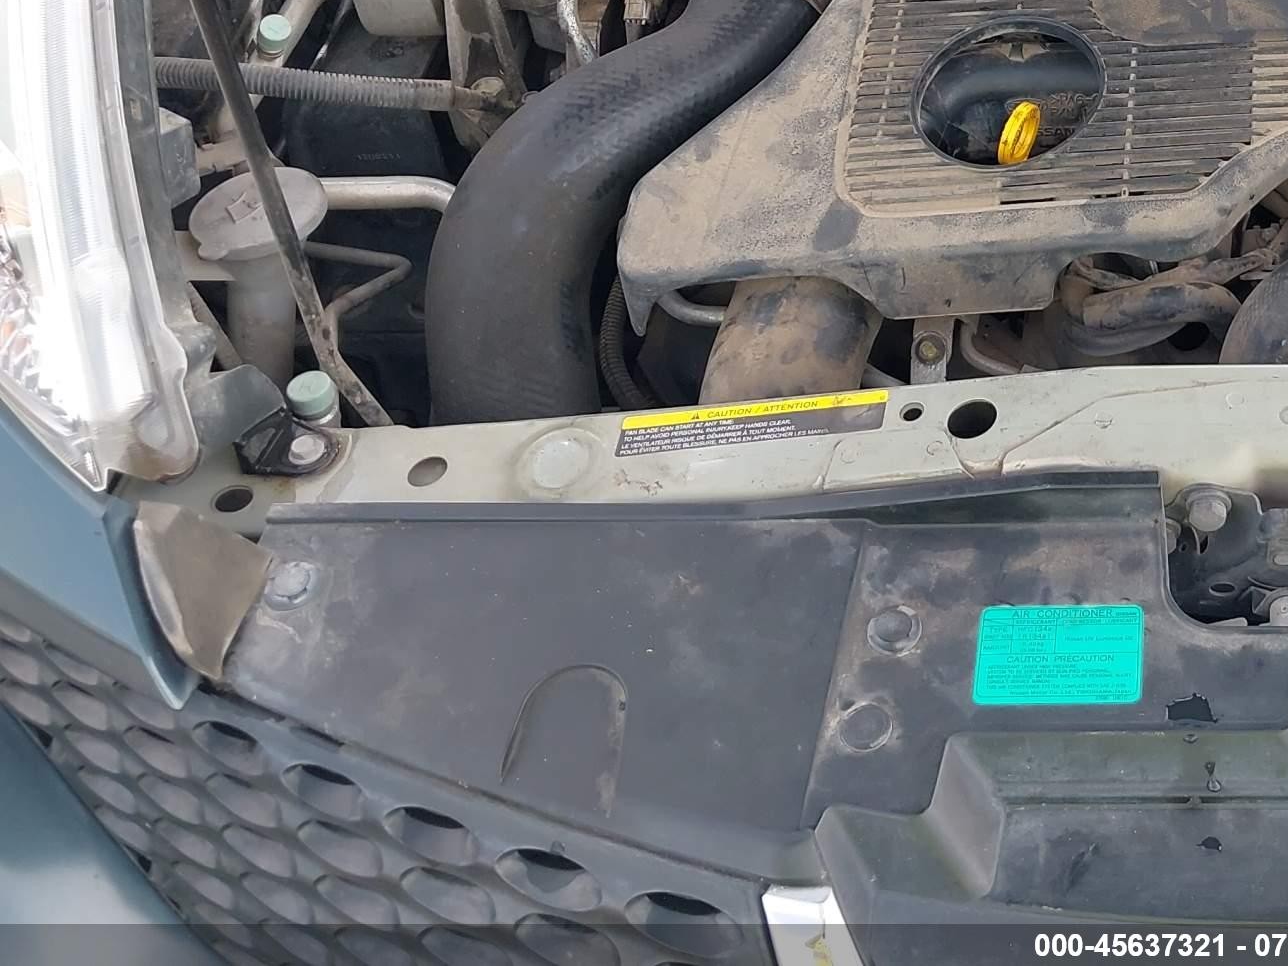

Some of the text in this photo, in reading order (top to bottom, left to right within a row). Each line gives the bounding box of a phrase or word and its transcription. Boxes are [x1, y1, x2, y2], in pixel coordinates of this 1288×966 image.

[707, 407, 752, 419] CAUTION
[762, 400, 819, 412] ATTENTION
[625, 428, 639, 436] FAN
[675, 423, 695, 431] START
[670, 429, 705, 437] PERSONAL
[745, 421, 768, 429] HANDS
[619, 448, 638, 456] POUR
[661, 443, 682, 451] TOUTE
[728, 436, 743, 444] PAS
[629, 439, 671, 449] VENTILATEUR
[1012, 609, 1113, 619] AIR CONDITIONER
[1007, 654, 1115, 663] CAUTION PRECAUTION
